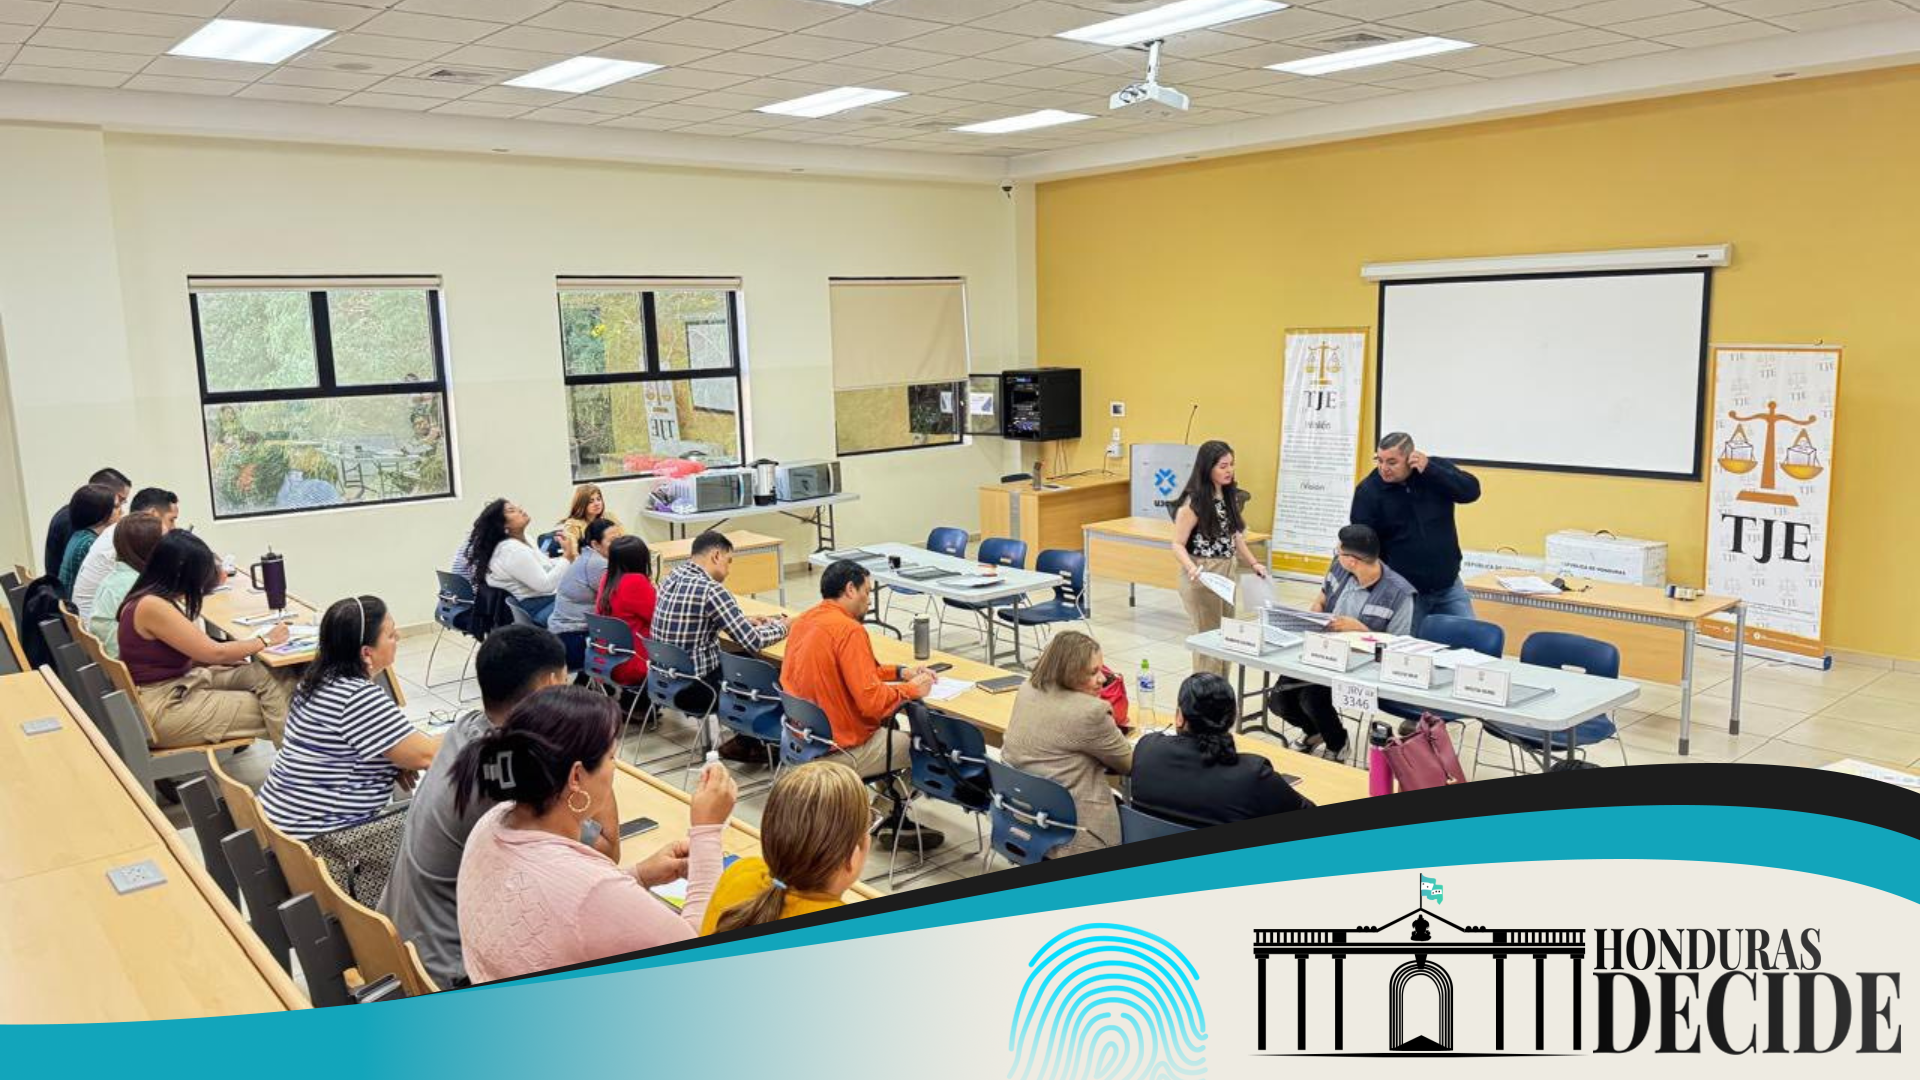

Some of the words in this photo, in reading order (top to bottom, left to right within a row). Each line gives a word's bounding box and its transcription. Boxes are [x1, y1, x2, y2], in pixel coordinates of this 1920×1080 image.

[1303, 389, 1338, 411] TJE
[1721, 513, 1811, 563] TJE
[1343, 695, 1371, 710] 3346
